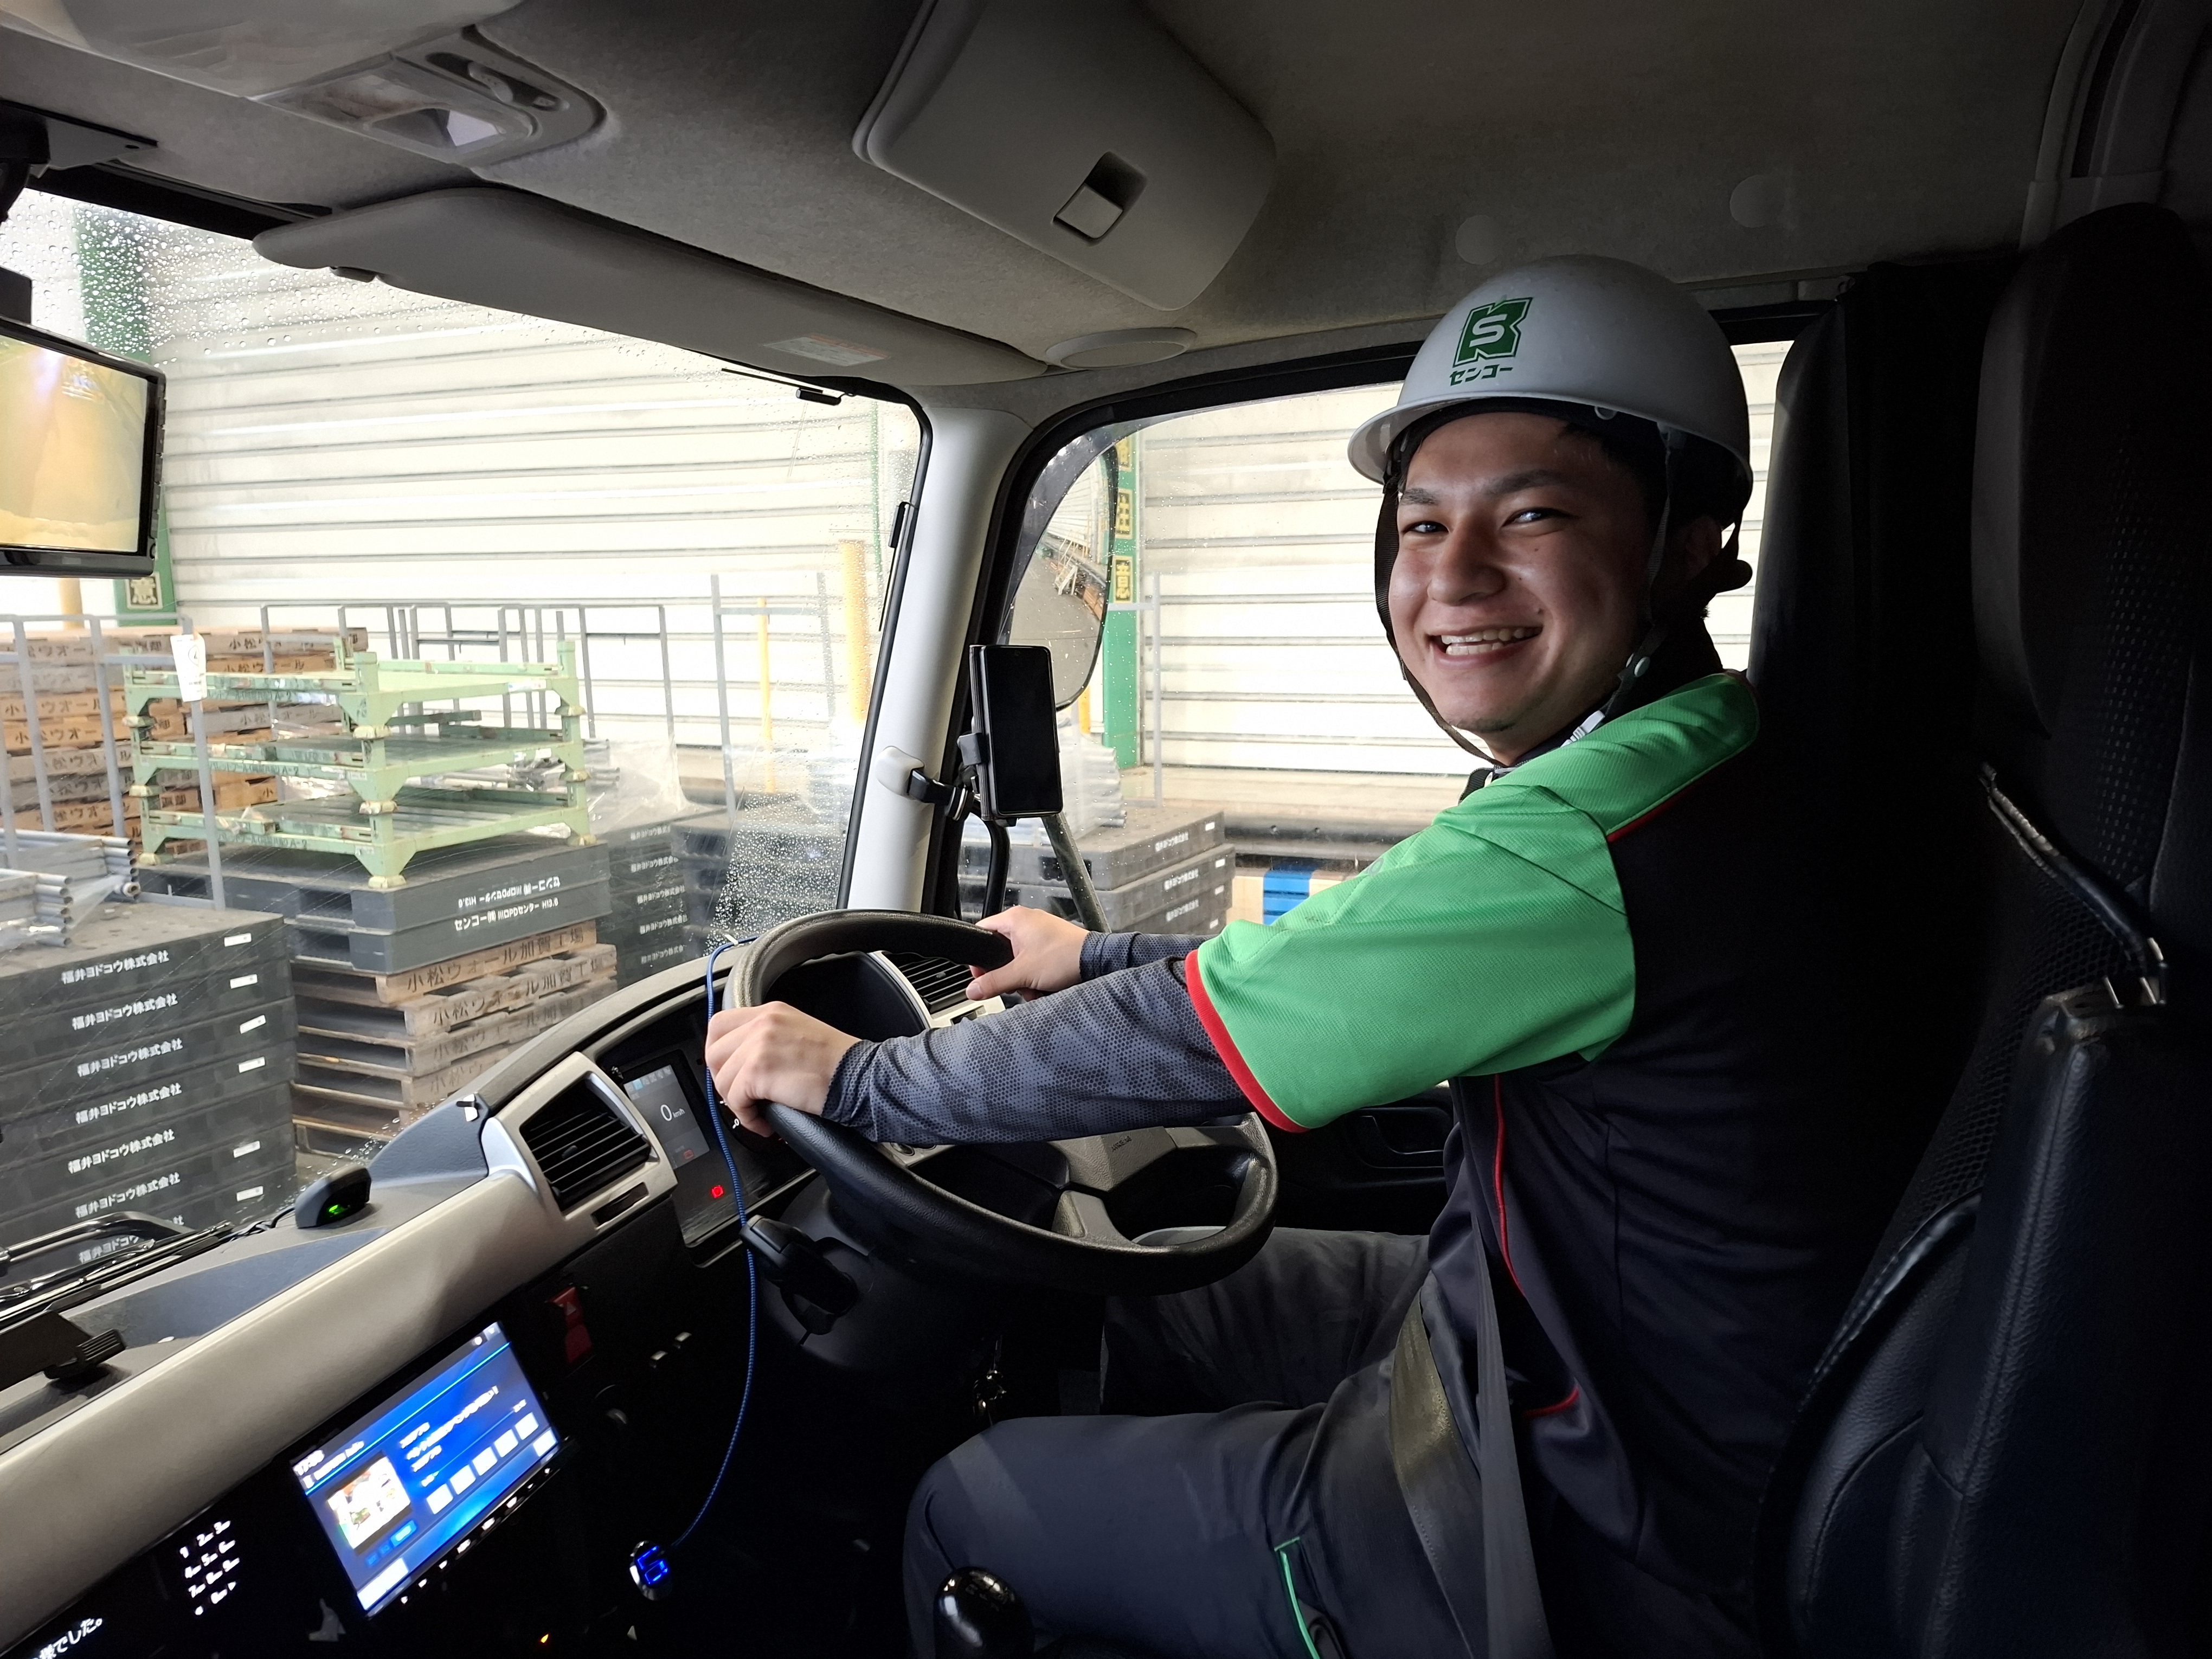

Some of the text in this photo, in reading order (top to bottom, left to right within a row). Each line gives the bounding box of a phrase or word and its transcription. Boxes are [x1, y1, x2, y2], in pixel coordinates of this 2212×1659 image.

[1449, 364, 1514, 386] センコー
[130, 577, 157, 604] 意
[61, 949, 170, 985] 福井ヨドコウ株式会社
[72, 993, 178, 1030] 福井ヨドコウ株式会社
[77, 1038, 183, 1078] 福井ヨドコウ株式会社
[75, 1082, 182, 1124] 福井ヨドコウ株式会社
[660, 1104, 672, 1121] 0
[68, 1128, 176, 1174] 福井ヨドコウ株式会社
[75, 1172, 181, 1219] 福井ヨドコウ株式会社
[31, 1618, 102, 1659] 様でした。
